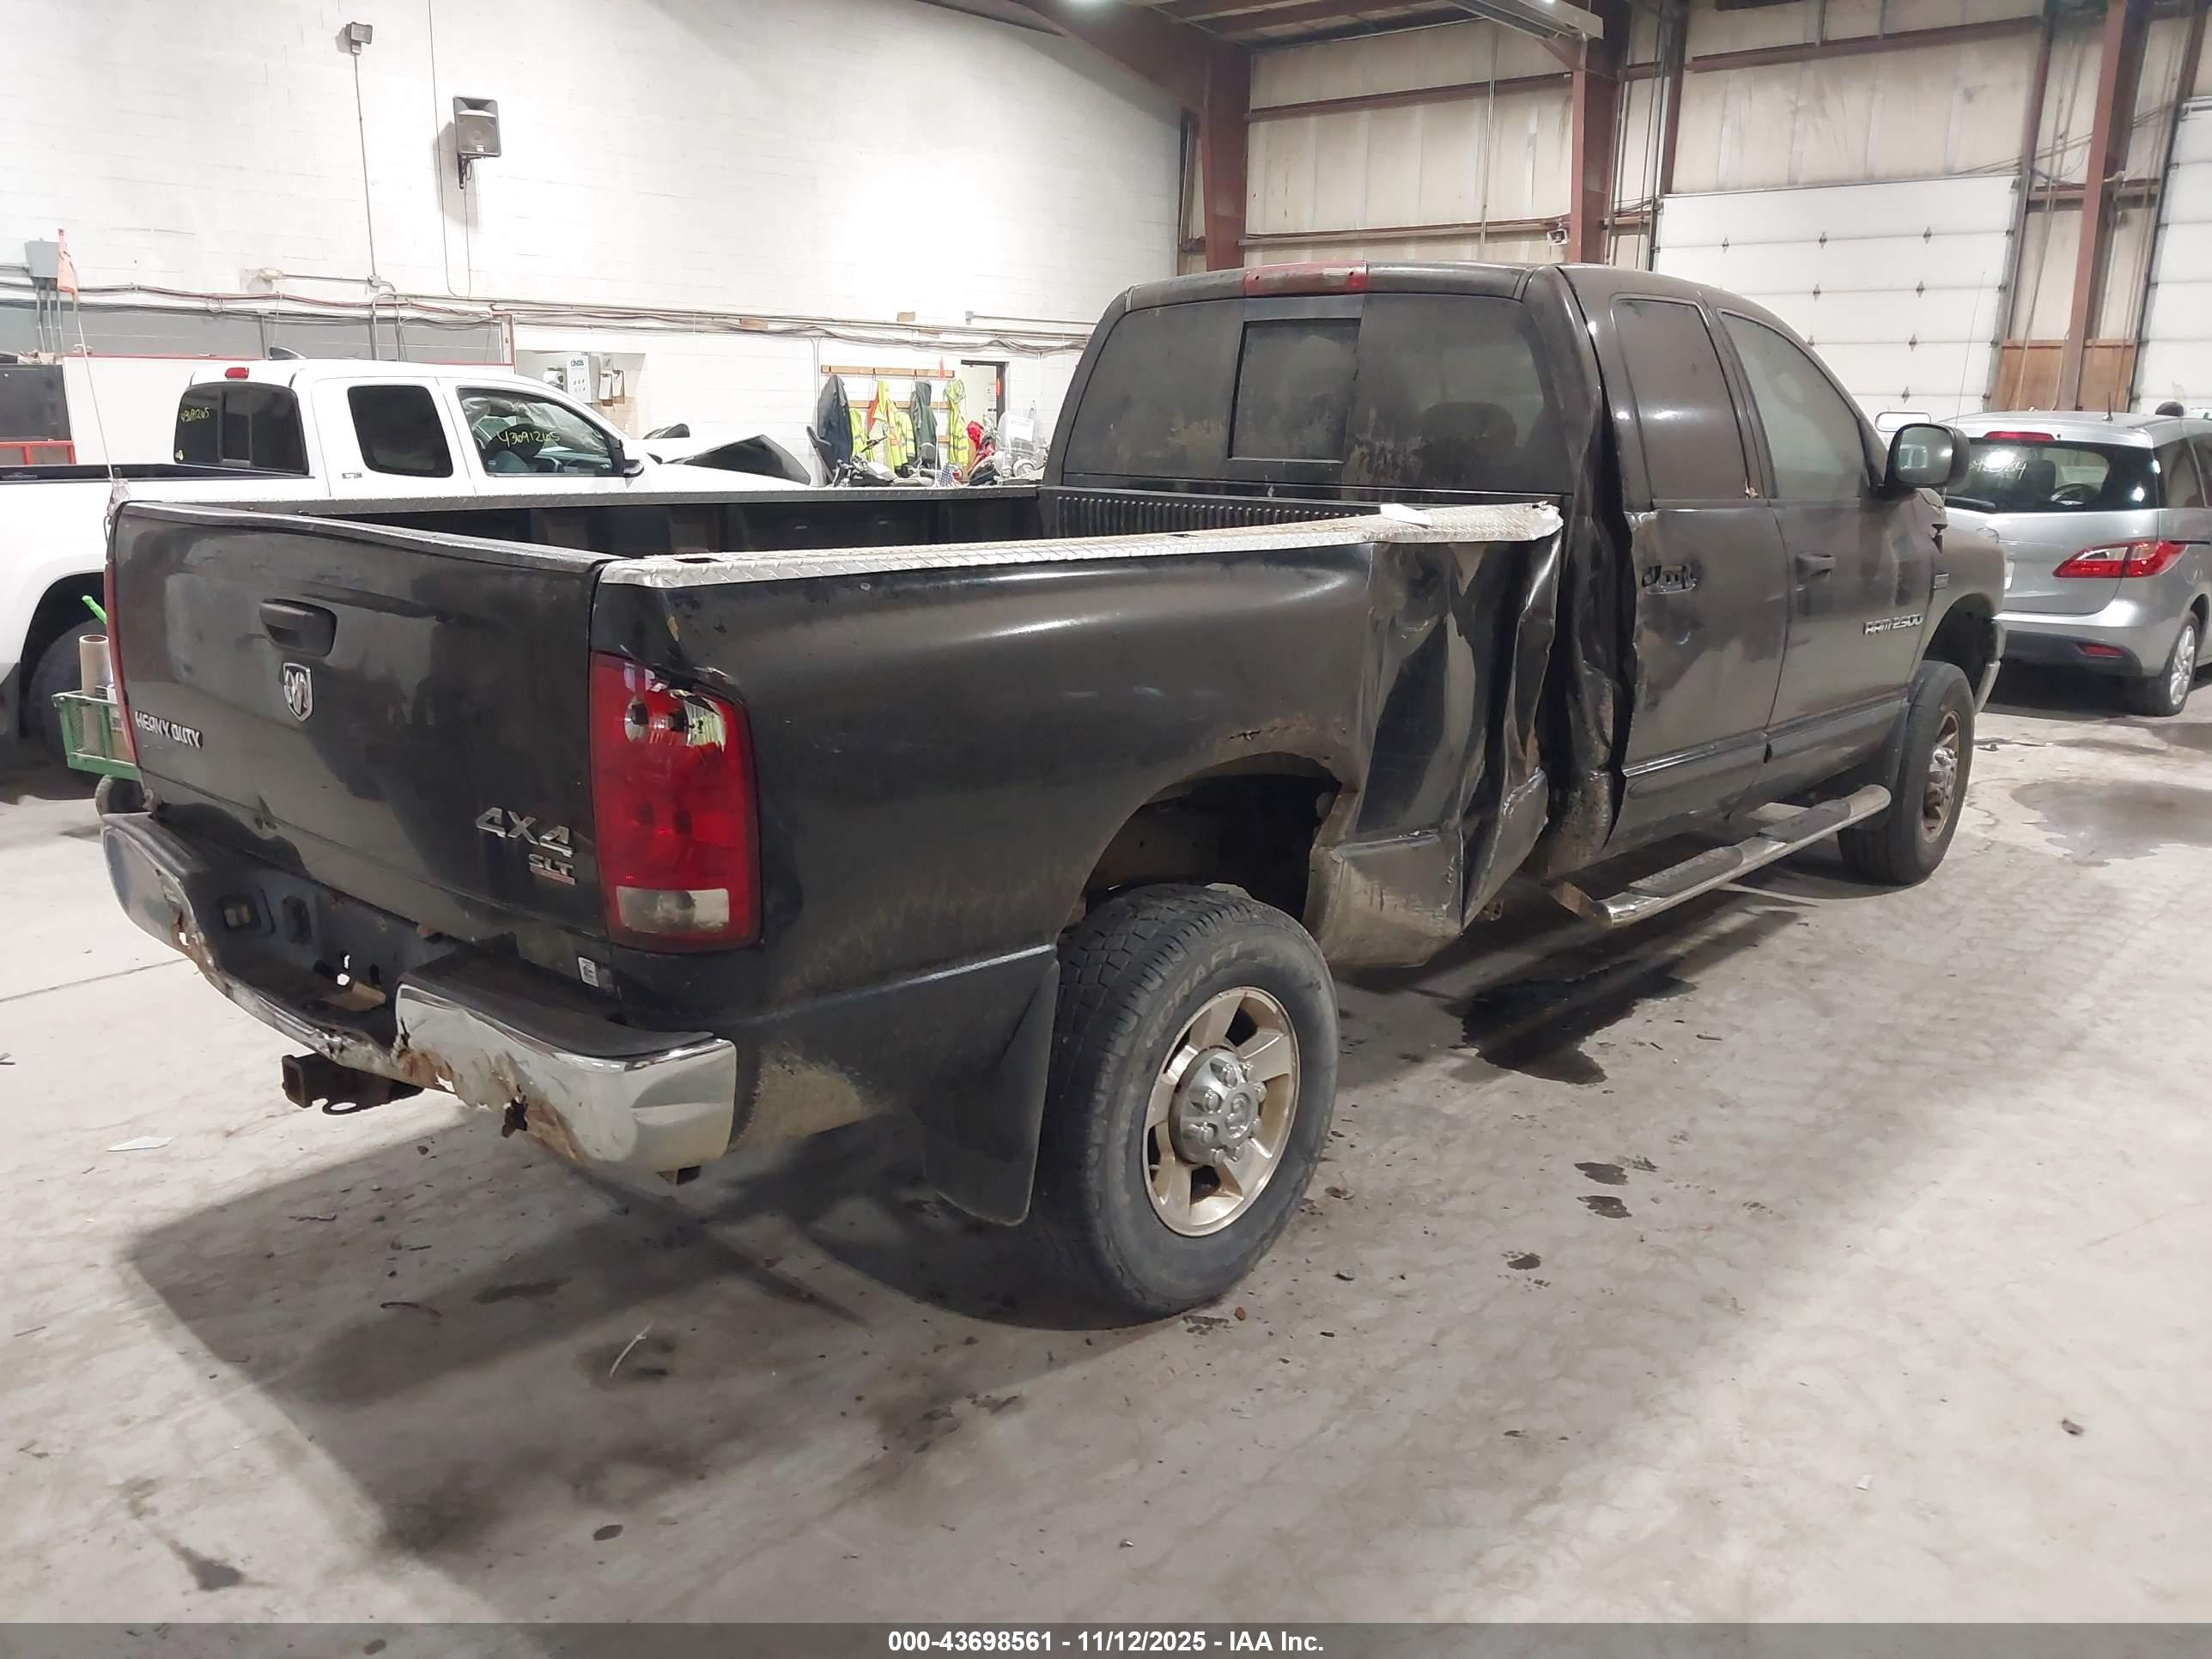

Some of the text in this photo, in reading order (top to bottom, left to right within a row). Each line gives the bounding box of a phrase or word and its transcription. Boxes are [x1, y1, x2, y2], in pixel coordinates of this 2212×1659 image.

[1892, 613, 1923, 629] 2500
[134, 710, 202, 750] HEAVY DUTY
[475, 806, 574, 858] 4X4
[528, 853, 574, 877] SLT
